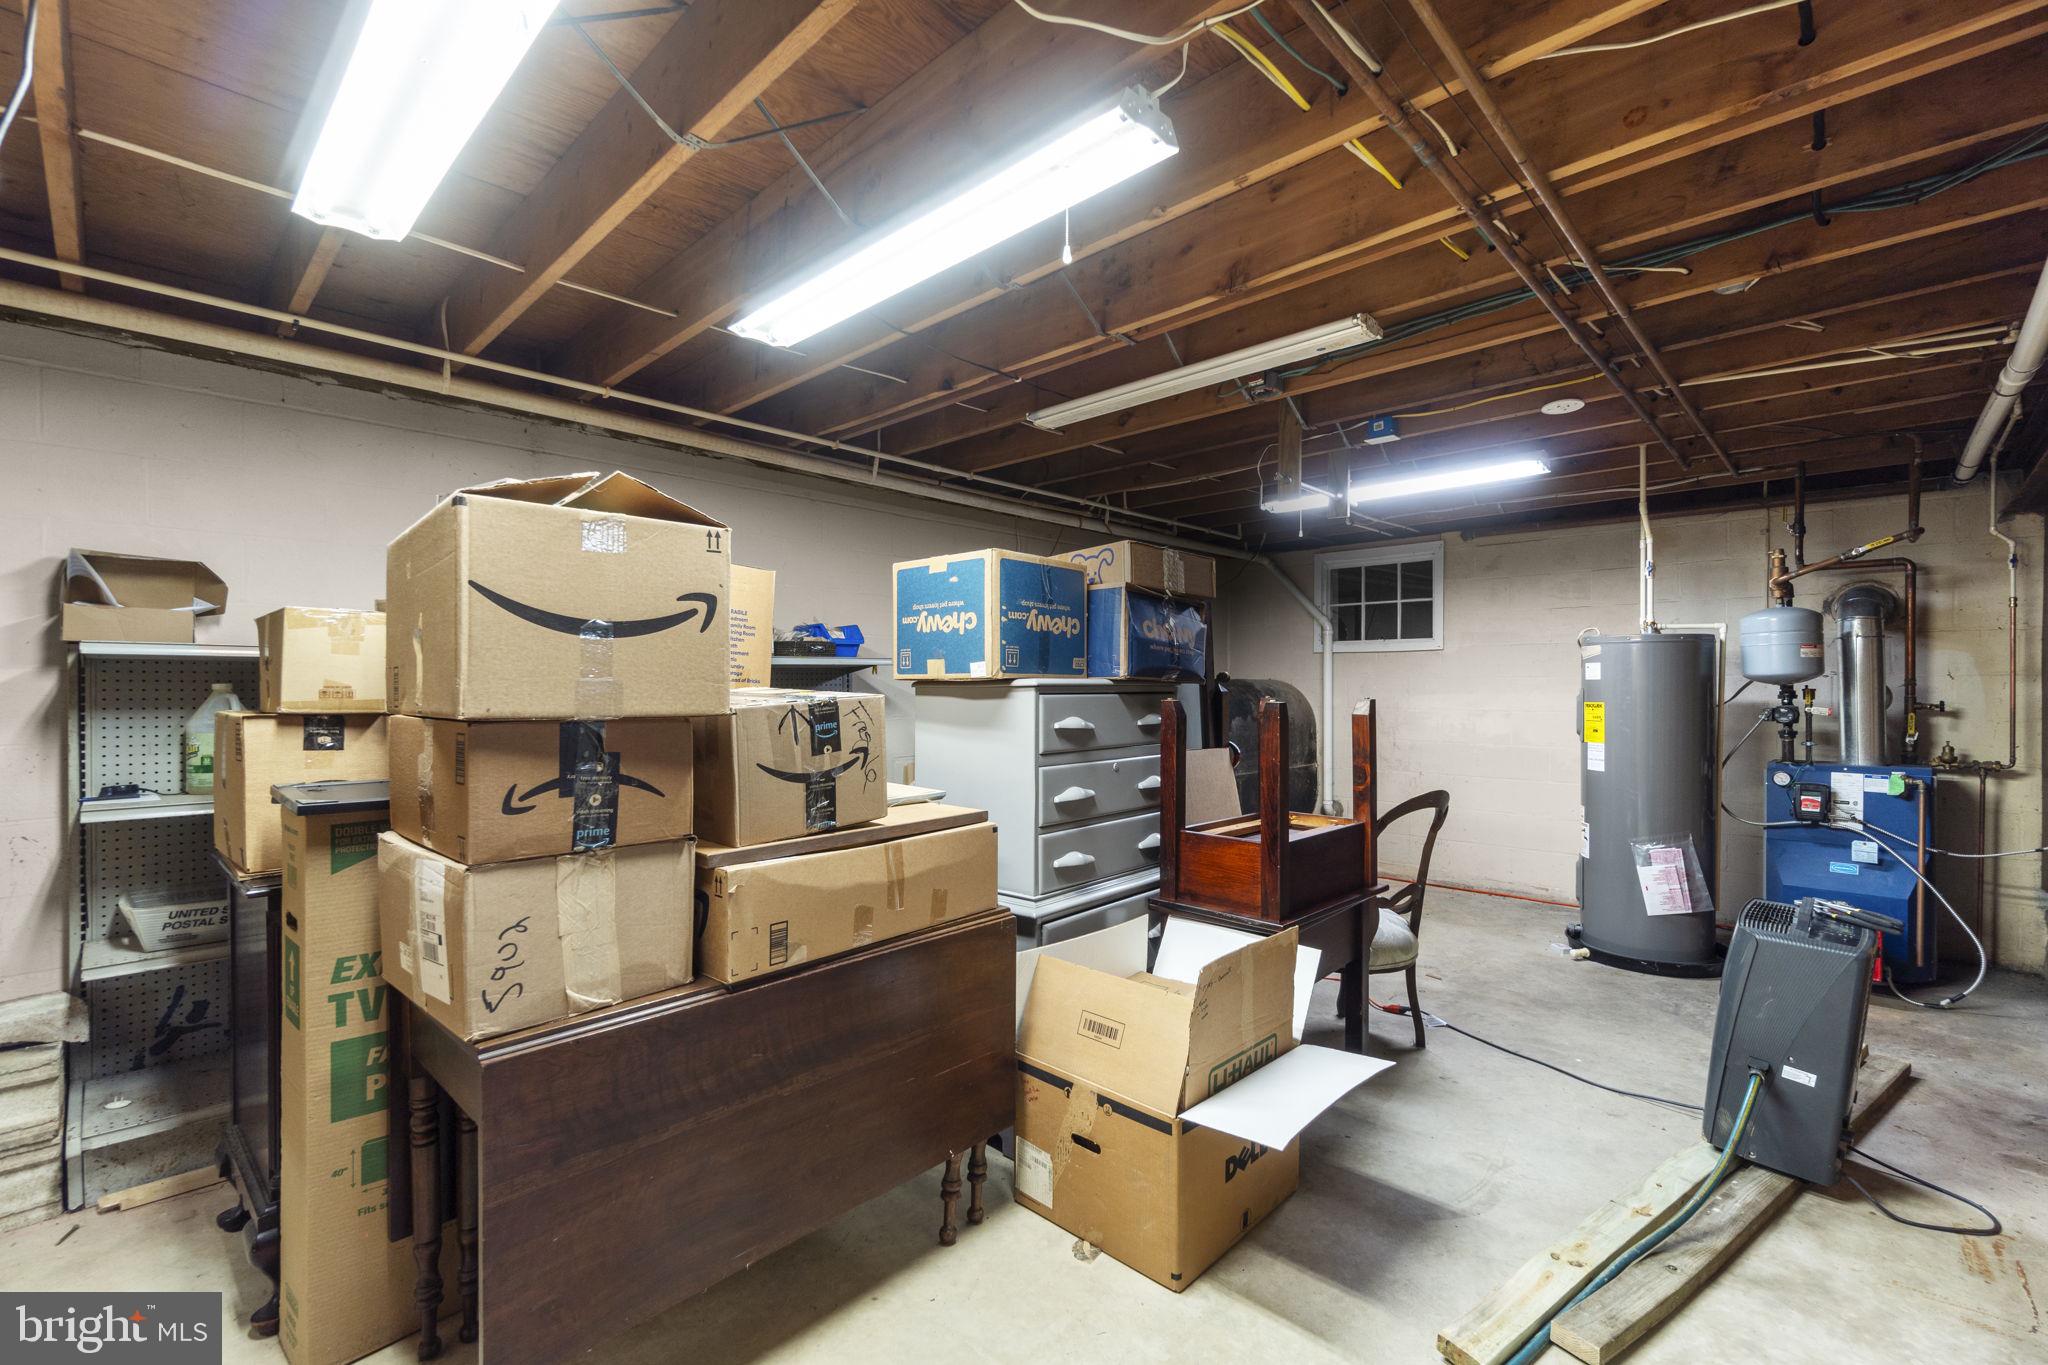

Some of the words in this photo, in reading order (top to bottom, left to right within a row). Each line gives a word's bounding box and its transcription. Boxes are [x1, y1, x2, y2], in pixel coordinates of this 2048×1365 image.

[902, 610, 978, 635] chewy.com
[1008, 608, 1081, 638] chewy.com
[815, 721, 838, 732] prime
[576, 827, 611, 840] prime
[168, 906, 219, 920] UNITED
[162, 918, 216, 931] POSTAL
[330, 951, 384, 985] EX
[327, 985, 387, 1029] TV
